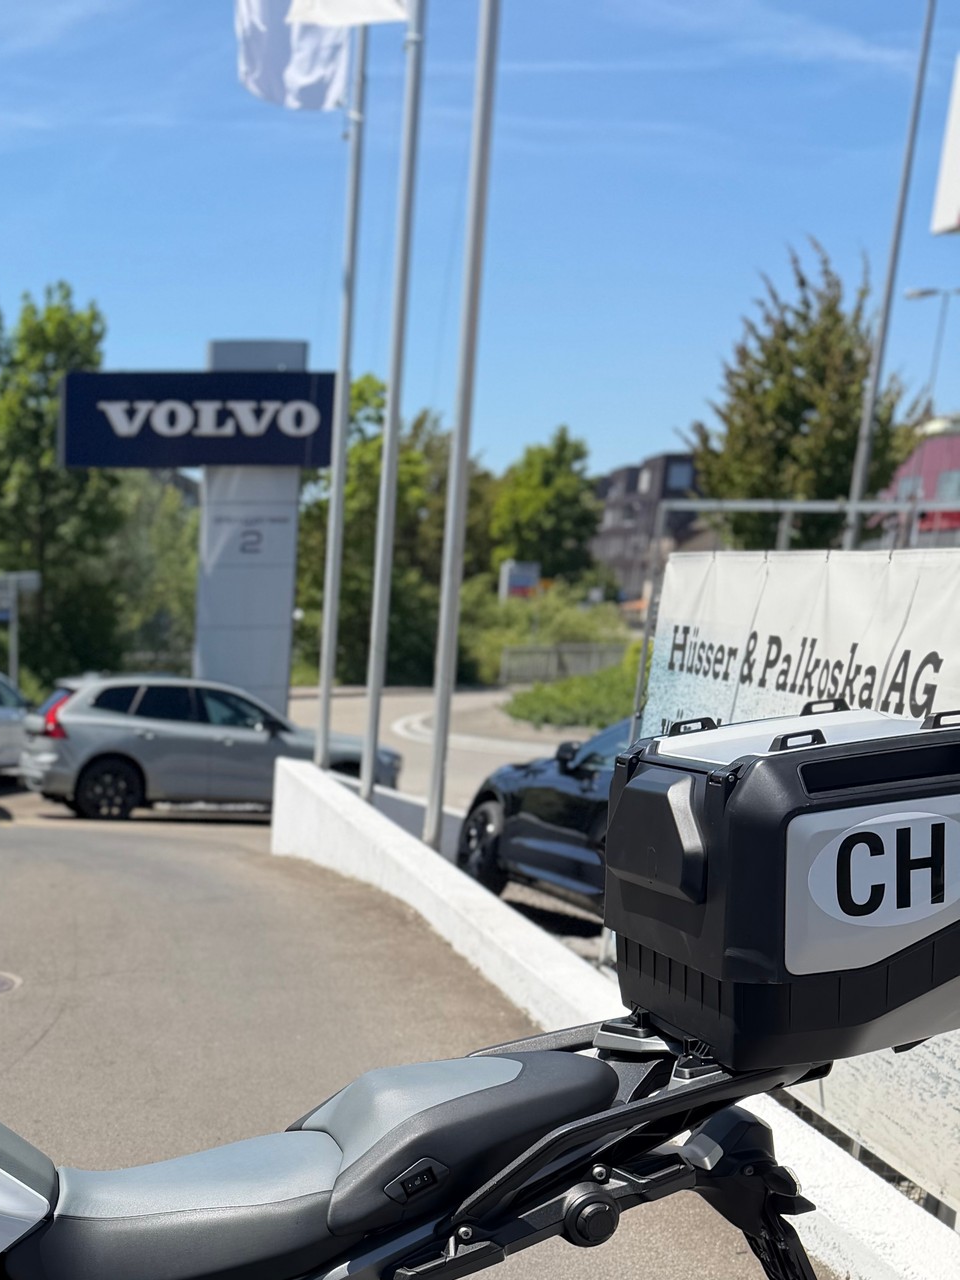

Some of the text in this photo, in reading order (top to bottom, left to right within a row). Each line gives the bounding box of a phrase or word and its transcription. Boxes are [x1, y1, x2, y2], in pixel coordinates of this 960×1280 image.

[97, 400, 321, 437] VOLVO
[240, 529, 263, 554] 2
[668, 624, 944, 719] Hüsser & Palkoska AG
[837, 823, 945, 917] CH
